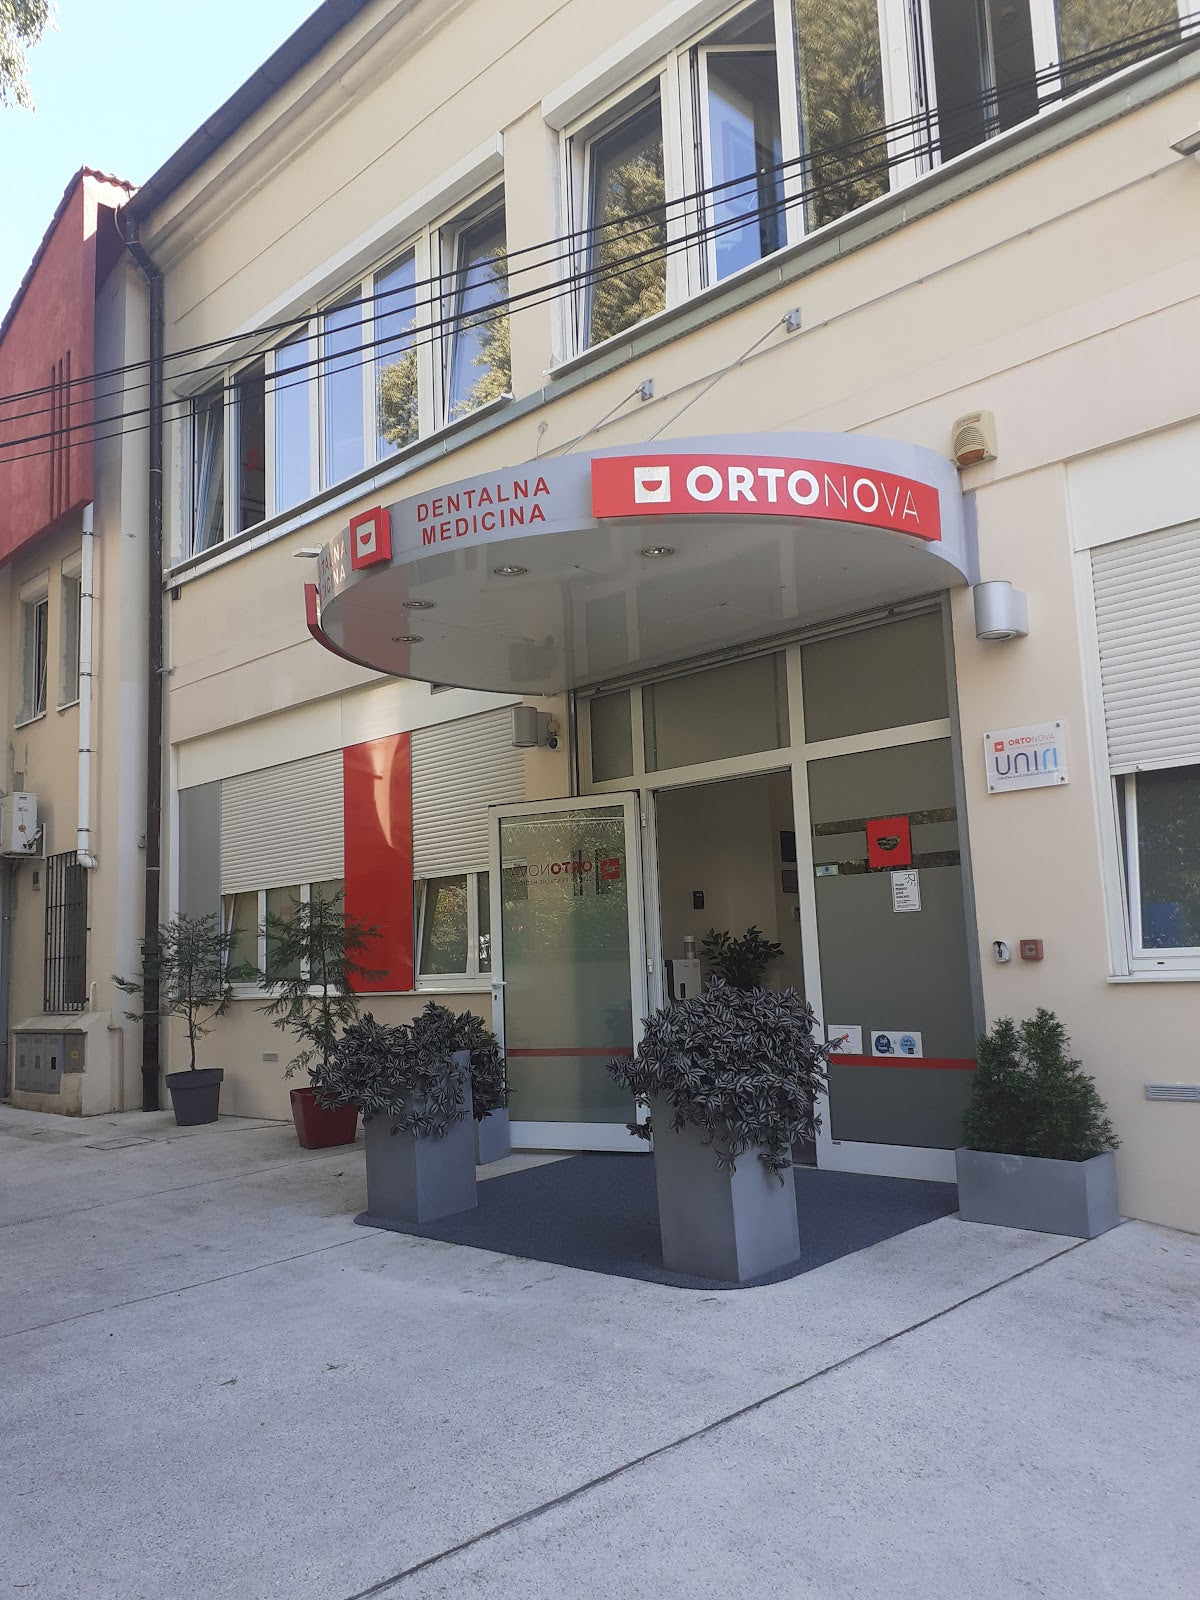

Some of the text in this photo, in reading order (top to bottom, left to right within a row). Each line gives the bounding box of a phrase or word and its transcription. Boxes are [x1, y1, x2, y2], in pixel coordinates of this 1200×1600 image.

[417, 476, 551, 523] DENTALNA
[686, 465, 920, 524] ORTONOVA
[422, 503, 546, 546] MEDICINA
[1008, 732, 1055, 746] ORTONOVA
